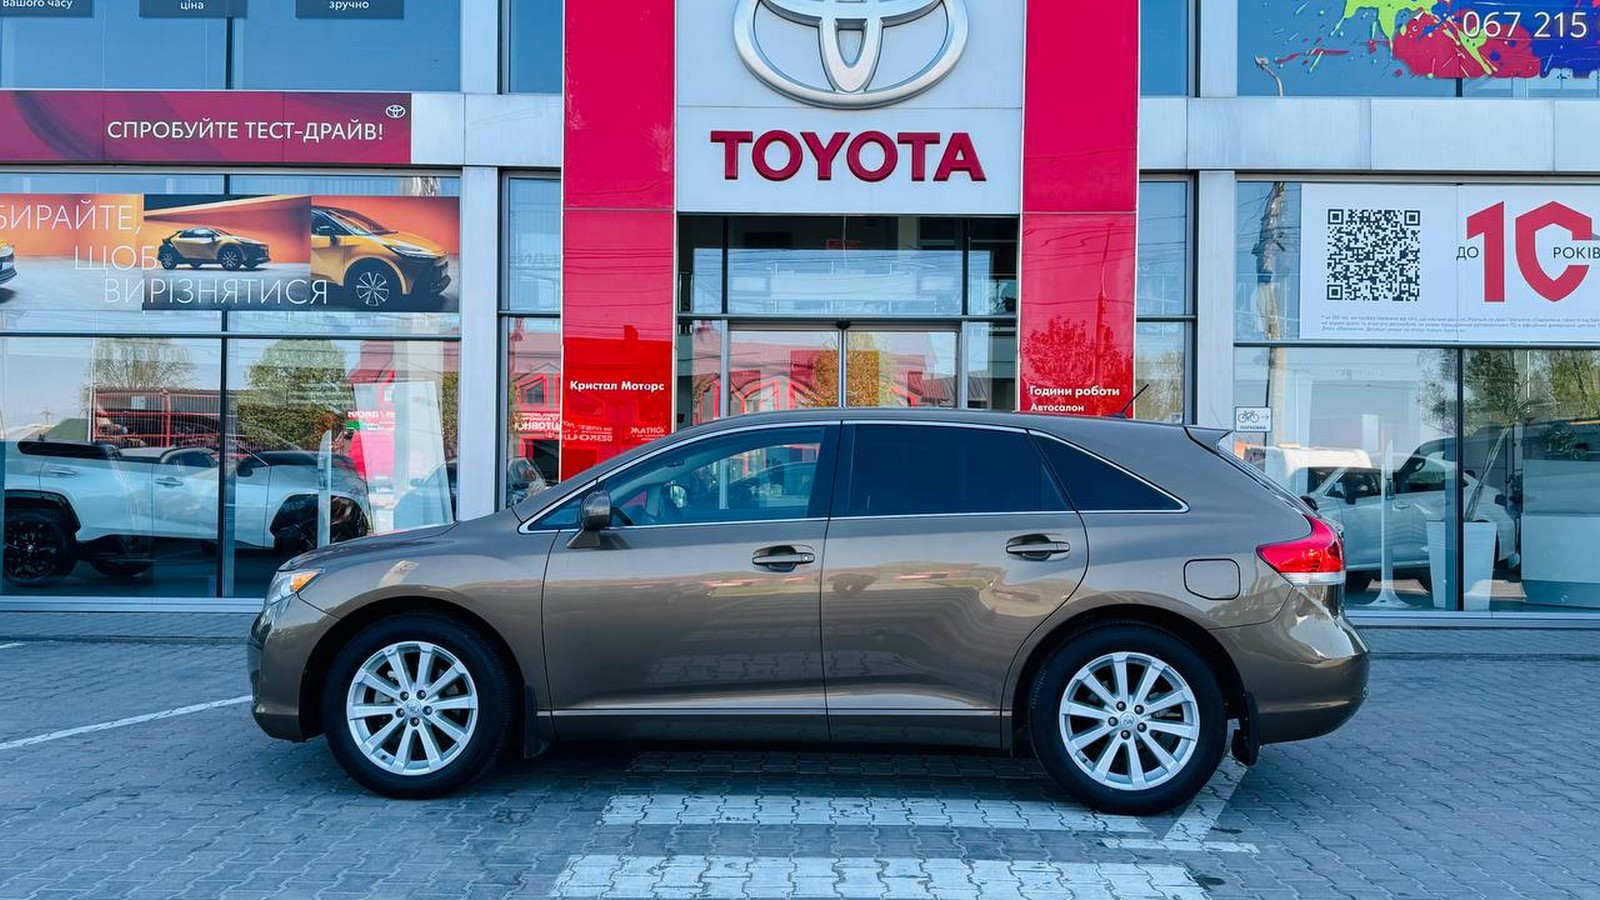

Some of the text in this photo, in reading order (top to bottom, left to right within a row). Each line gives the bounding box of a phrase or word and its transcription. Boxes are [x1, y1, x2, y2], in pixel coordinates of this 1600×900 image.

[48, 0, 73, 10] часу
[180, 0, 205, 11] ціна
[329, 0, 371, 11] зручно
[1463, 11, 1588, 38] 067 215
[107, 117, 384, 142] СПРОБУЙТЕ ТЕСТ-ДРАЙВ!
[710, 130, 988, 183] TOYOTA
[1456, 246, 1479, 260] ДО
[1553, 246, 1600, 260] РОКІВ
[74, 245, 157, 277] ЩОБ
[104, 278, 328, 306] ВИРІЗНЯТИСЯ
[570, 380, 665, 392] Кристал Моторс
[1030, 385, 1120, 398] Години роботи
[1030, 403, 1084, 412] Автосалон
